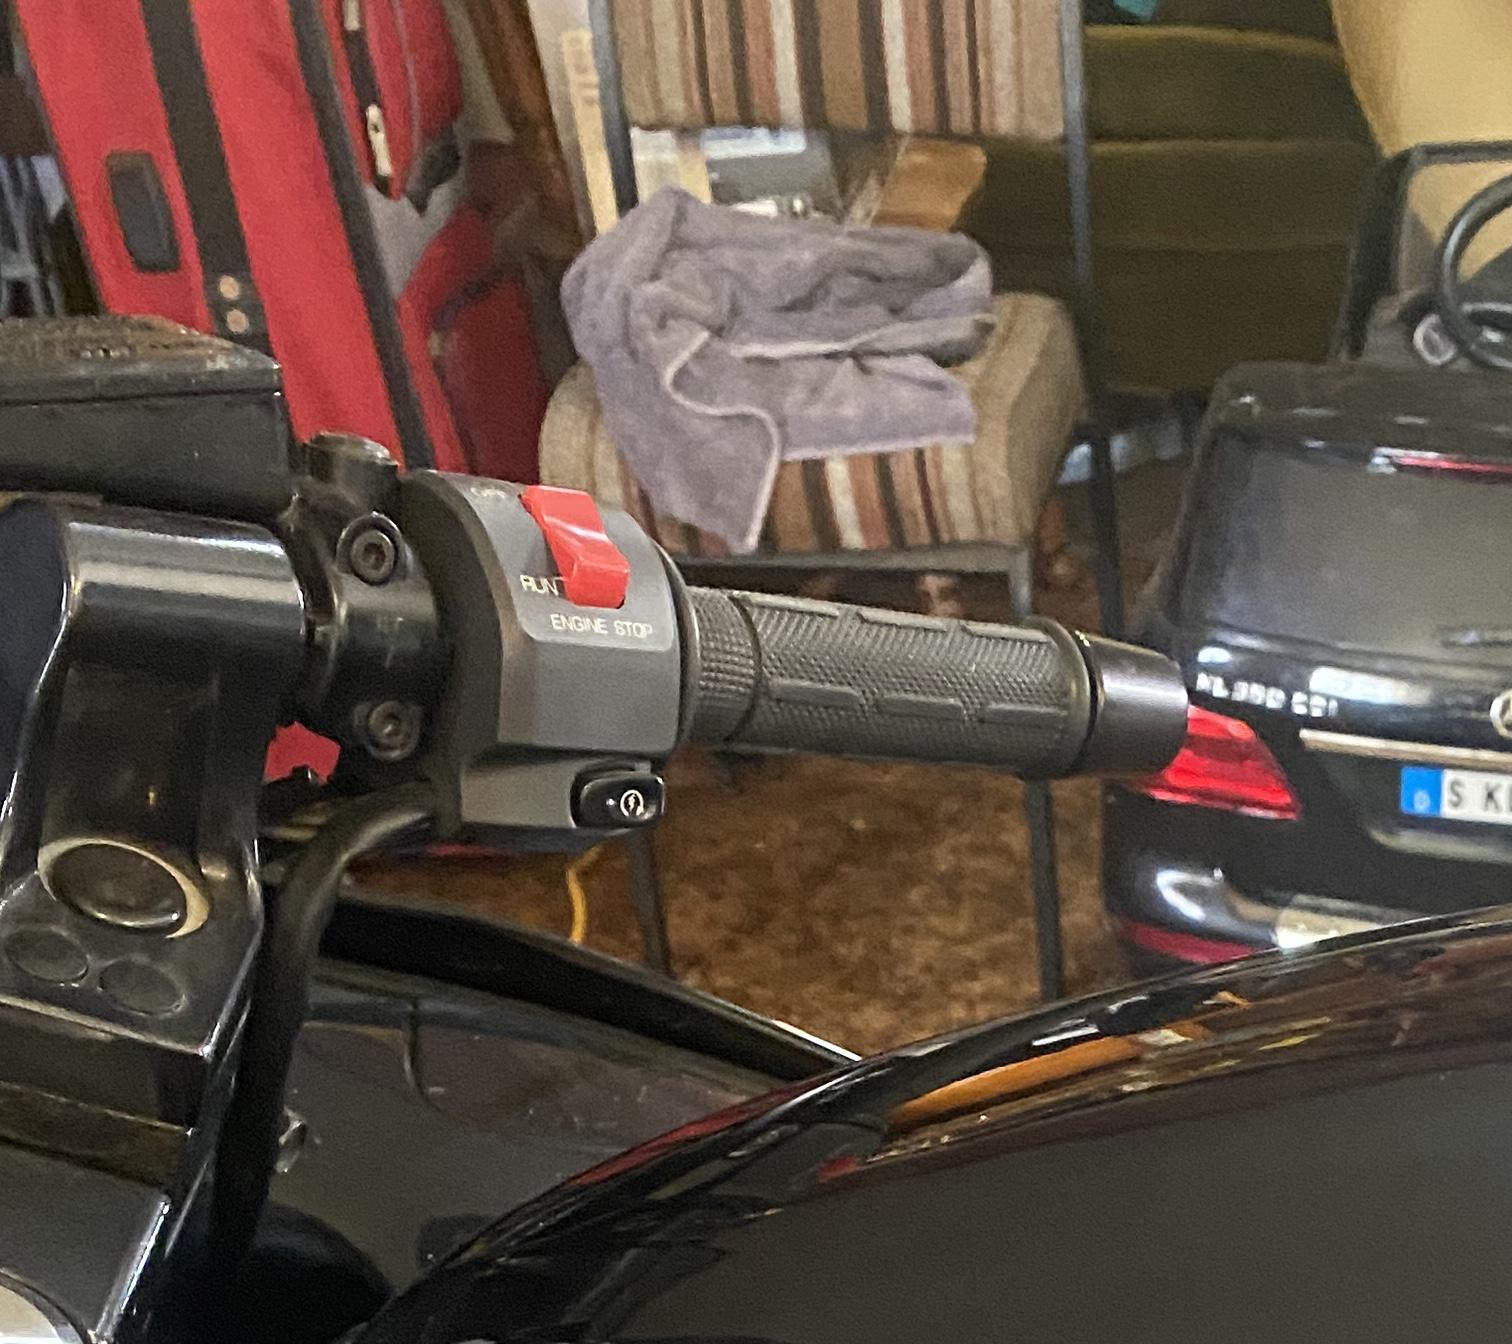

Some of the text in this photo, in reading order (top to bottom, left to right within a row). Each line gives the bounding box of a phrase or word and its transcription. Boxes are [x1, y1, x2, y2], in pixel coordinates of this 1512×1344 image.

[519, 574, 559, 596] RUN
[550, 613, 653, 638] ENGINE STOP
[1449, 778, 1465, 808] S
